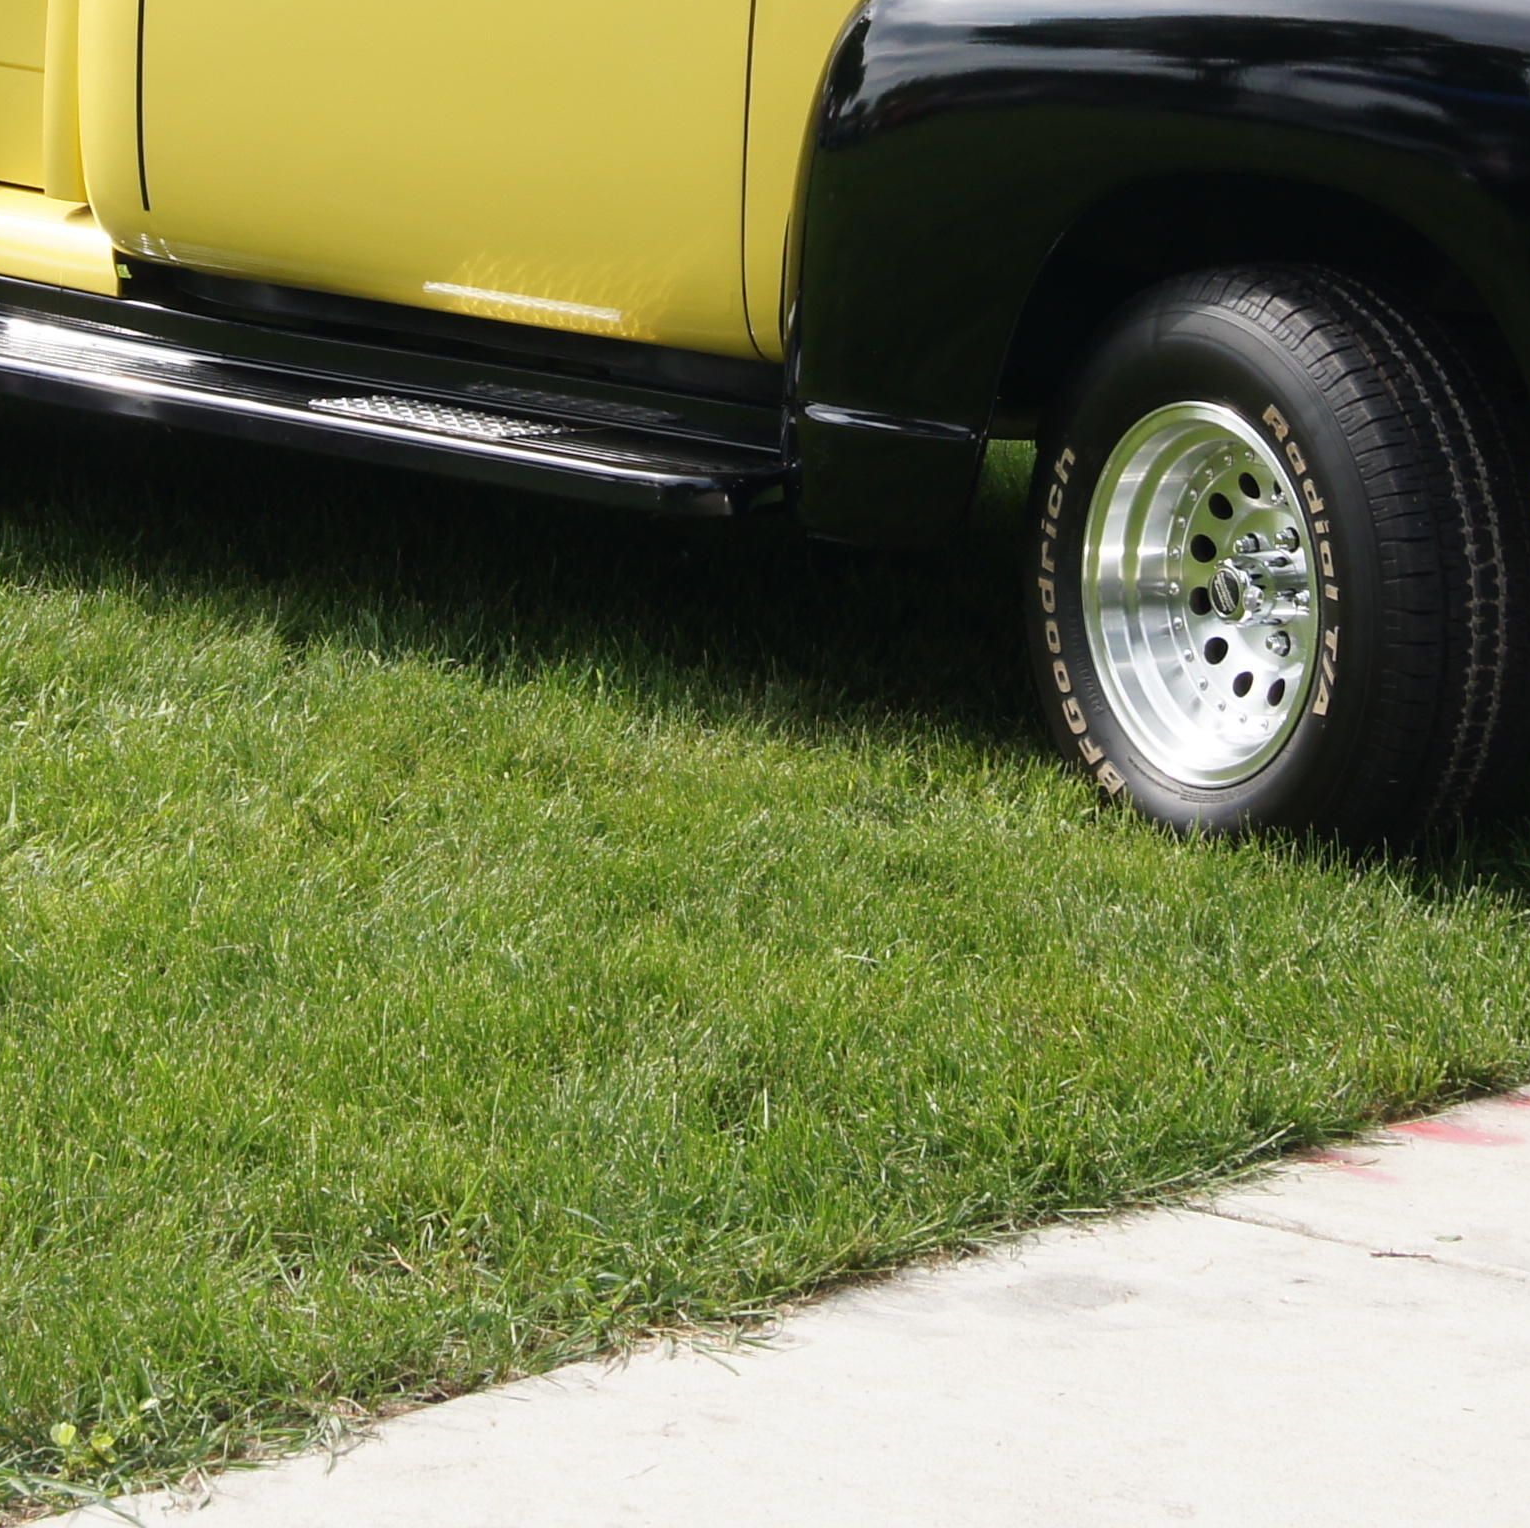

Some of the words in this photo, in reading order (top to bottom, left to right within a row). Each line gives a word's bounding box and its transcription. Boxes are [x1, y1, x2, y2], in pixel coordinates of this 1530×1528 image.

[1037, 446, 1128, 796] BFGoodrich
[1262, 404, 1340, 601] Radial
[1312, 626, 1340, 716] T/A
